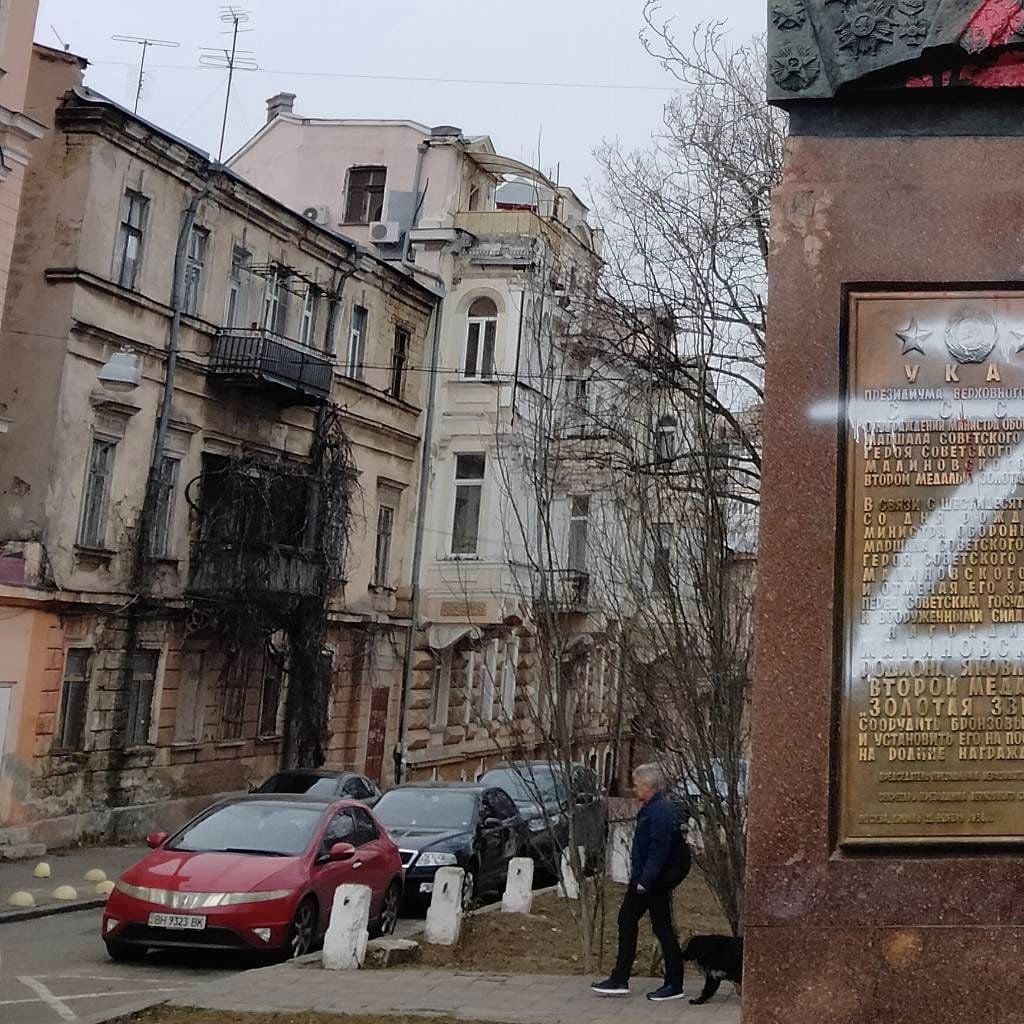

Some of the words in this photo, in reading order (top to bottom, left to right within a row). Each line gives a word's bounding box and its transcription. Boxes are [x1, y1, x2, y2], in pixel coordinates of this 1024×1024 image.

[865, 388, 943, 401] ПРЕЗИДИУМА
[948, 420, 998, 432] МИНИСТРА
[864, 433, 930, 446] МАРШАЛА
[939, 433, 1020, 445] СОВЕТСКОГО
[864, 446, 912, 459] ГЕРОЯ
[922, 446, 1012, 459] СОВЕТСКОГО
[865, 459, 1024, 473] МАЛИНОВСКОГО
[864, 473, 909, 487] ВТОРОЙ
[864, 497, 872, 512] В
[879, 497, 920, 512] СВЯЗИ
[927, 497, 936, 511] С
[863, 512, 886, 526] СО
[904, 512, 944, 525] ДНЯ
[864, 526, 944, 539] МИНИСТРА
[864, 539, 927, 553] МАРШАЛА
[939, 539, 1023, 552] СОВЕТСКОГО
[863, 553, 911, 566] ГЕРОЯ
[923, 552, 1016, 566] СОВЕТСКОГО
[862, 582, 871, 595] И
[881, 582, 958, 595] ОТМЕЧАЯ
[969, 582, 993, 594] ЕГО
[862, 596, 898, 610] ПЕРЕД
[906, 595, 980, 609] СОВЕТСКИМ
[861, 611, 869, 625] И
[879, 610, 982, 624] ВООРУЖЕННЫМИ
[862, 660, 950, 679] РОДИОНА
[870, 678, 957, 697] ВТОРОЙ
[859, 717, 940, 732] СООРУДИТЬ
[859, 732, 867, 746] И
[875, 732, 953, 746] УСТАНОВИТЬ
[959, 732, 981, 745] ЕГО
[986, 732, 1001, 745] НА
[859, 747, 875, 762] НА
[889, 746, 945, 761] РОДИНЕ
